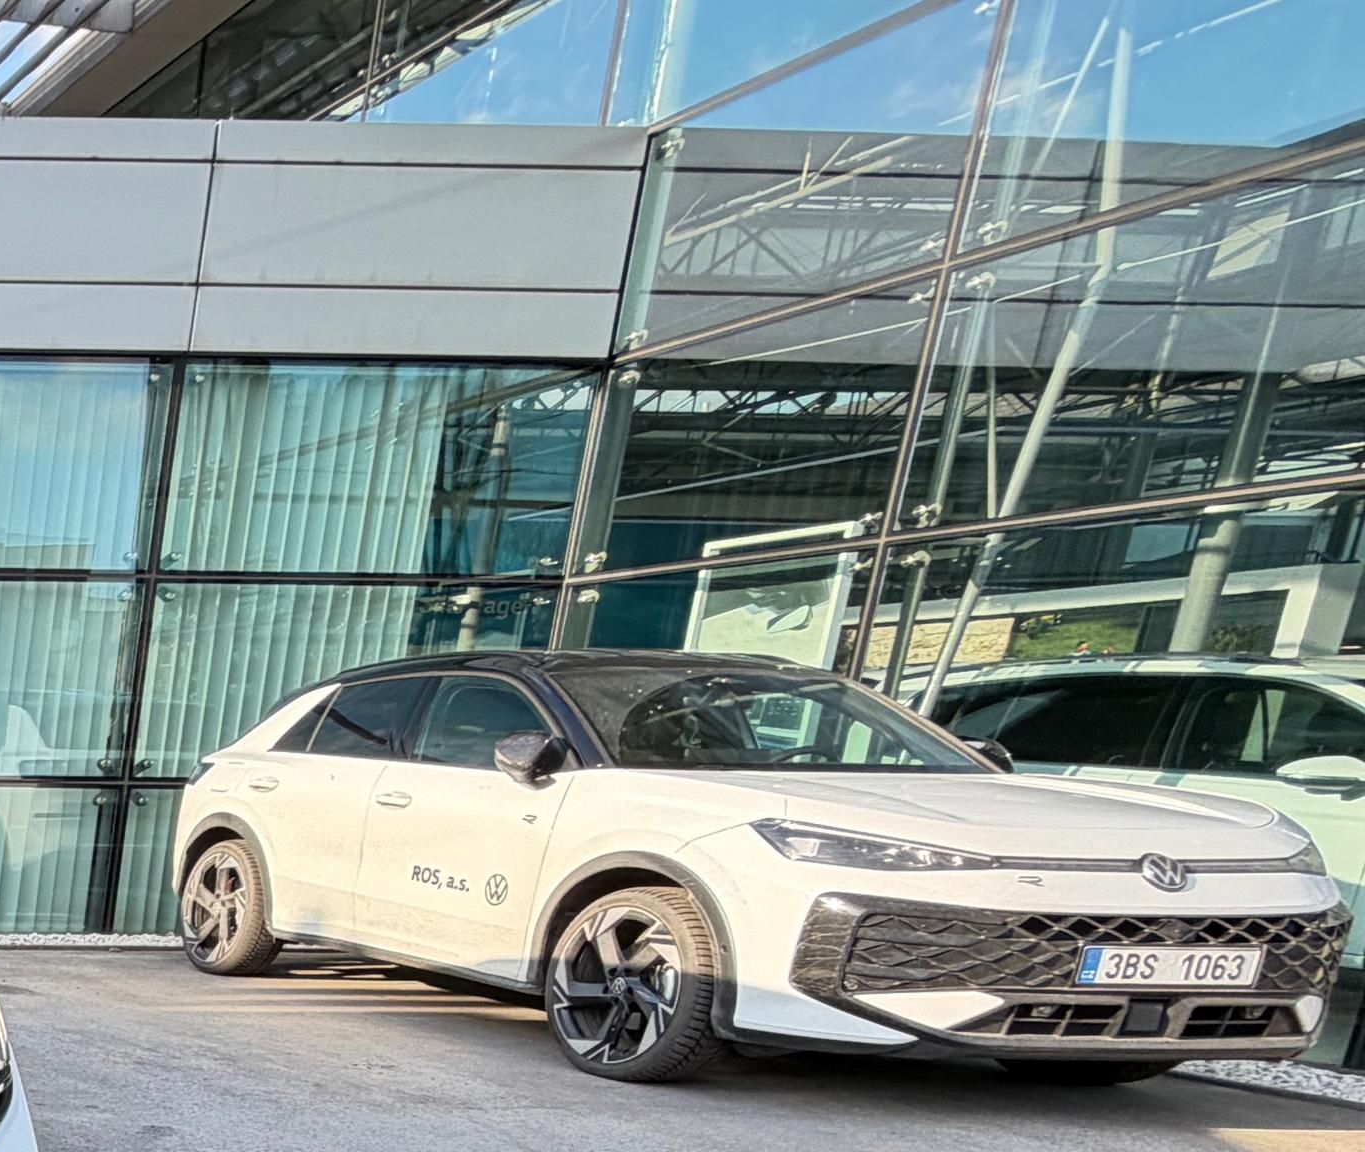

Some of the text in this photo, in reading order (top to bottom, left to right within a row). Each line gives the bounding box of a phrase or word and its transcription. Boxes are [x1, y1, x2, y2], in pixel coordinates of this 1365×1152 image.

[411, 865, 470, 892] ROS, a.s.
[1105, 953, 1245, 981] 3BS 1063
